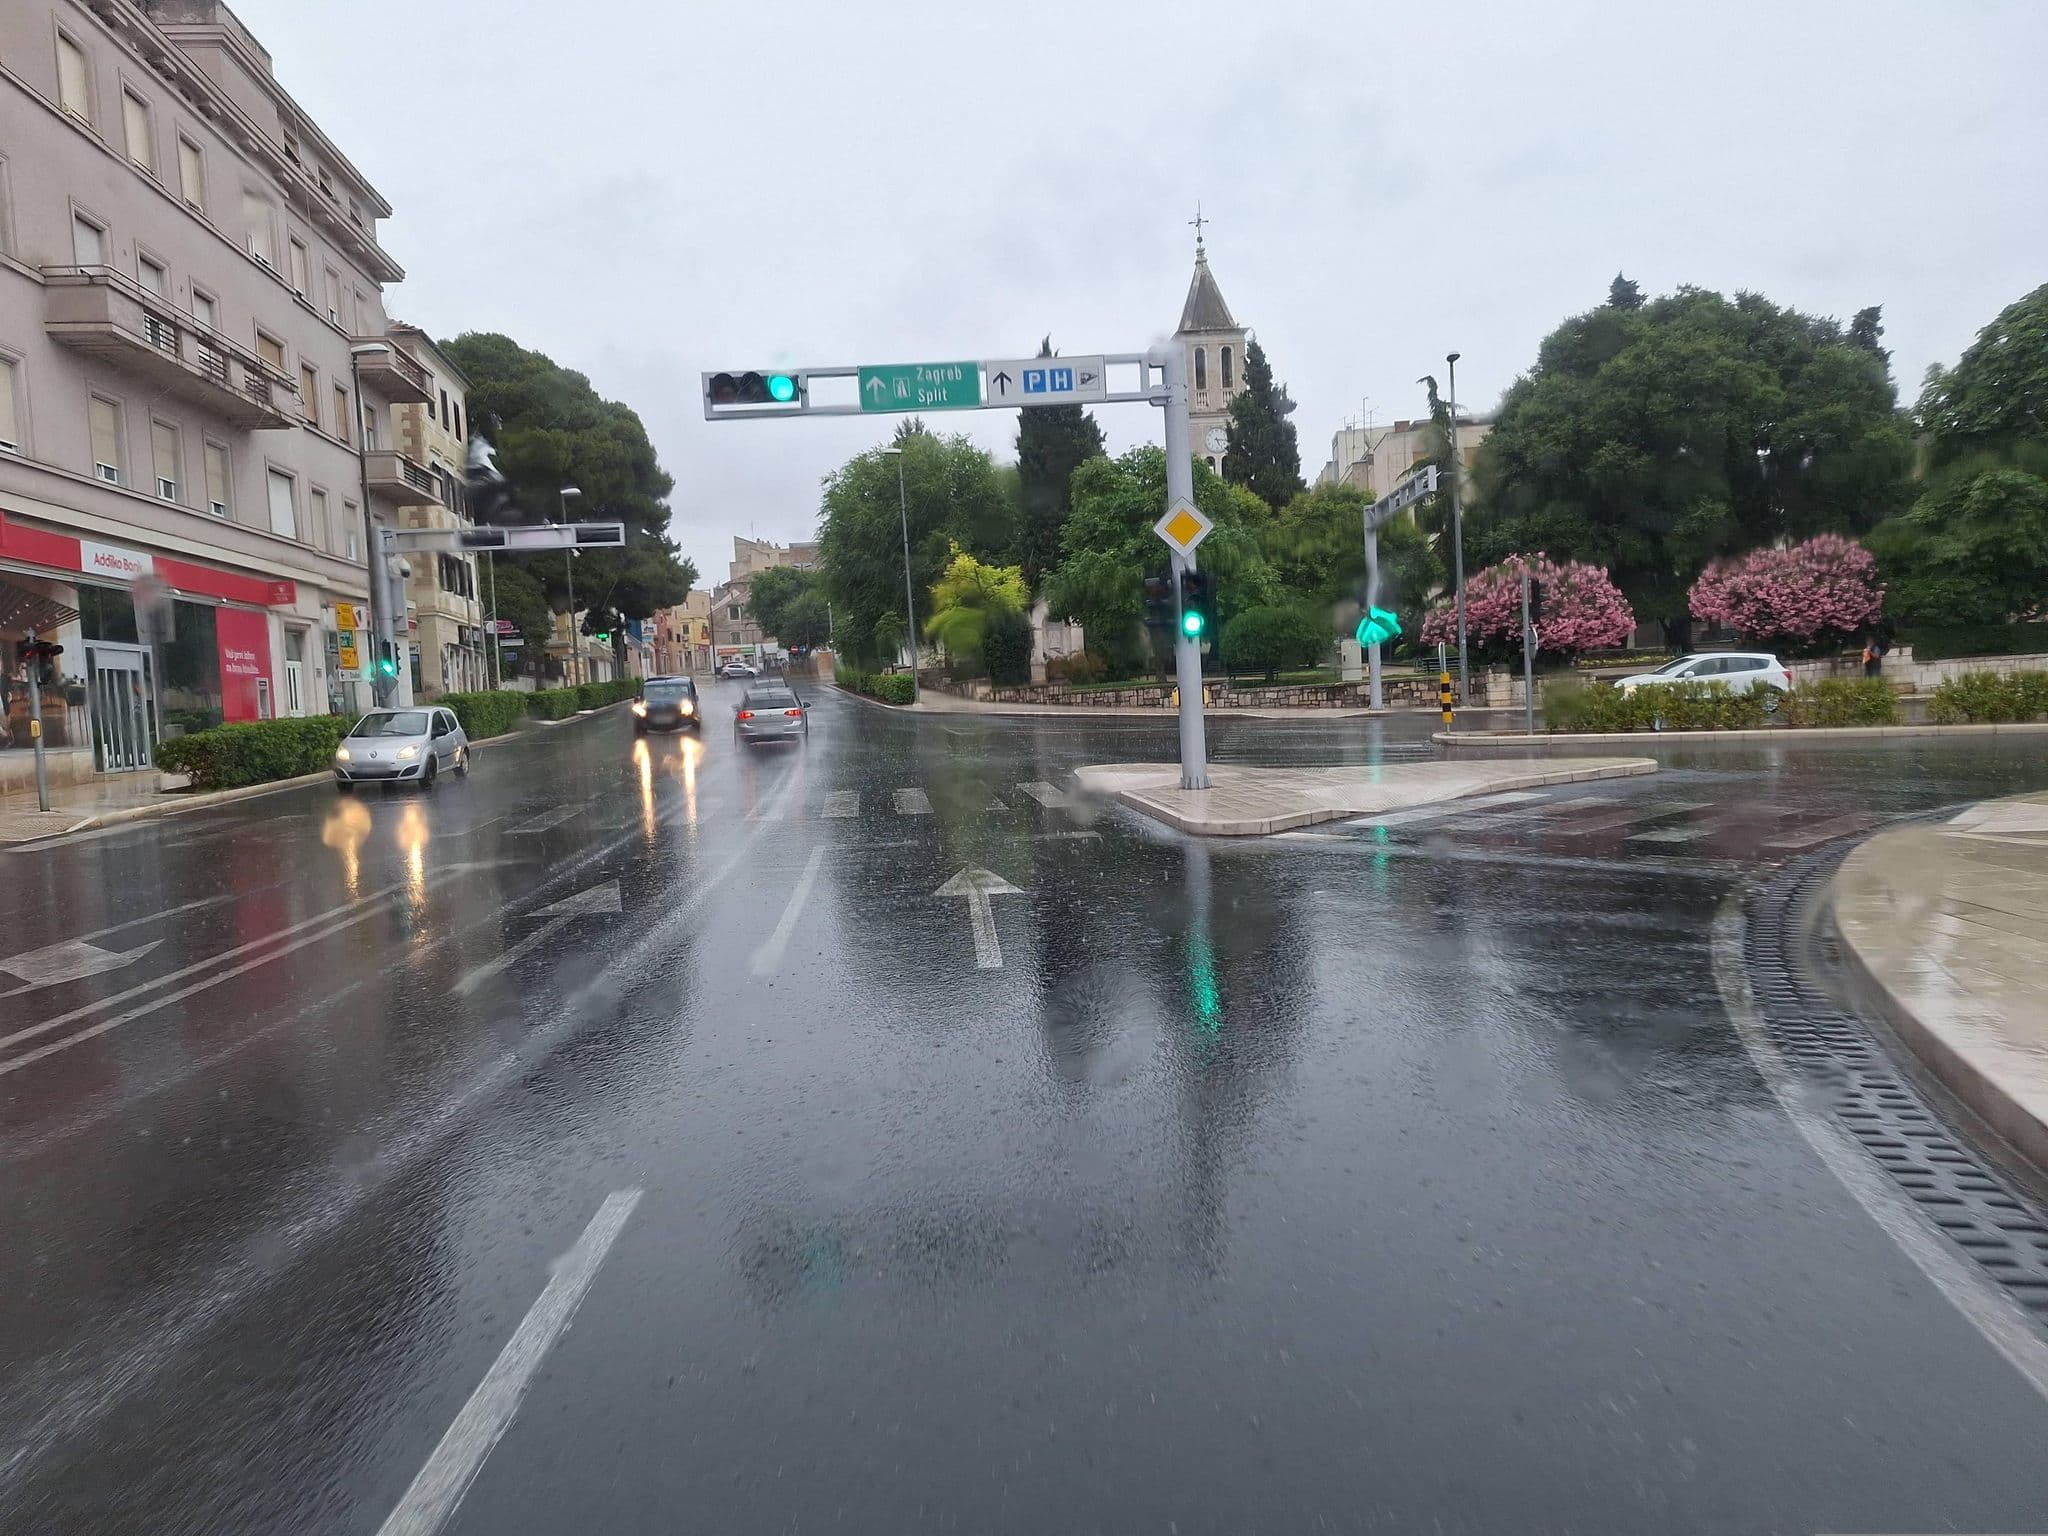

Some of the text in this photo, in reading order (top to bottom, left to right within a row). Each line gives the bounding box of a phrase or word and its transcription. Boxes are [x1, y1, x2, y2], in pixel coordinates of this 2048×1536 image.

[916, 365, 962, 385] Zagreb
[918, 387, 948, 405] Split
[94, 552, 122, 570] Addiko
